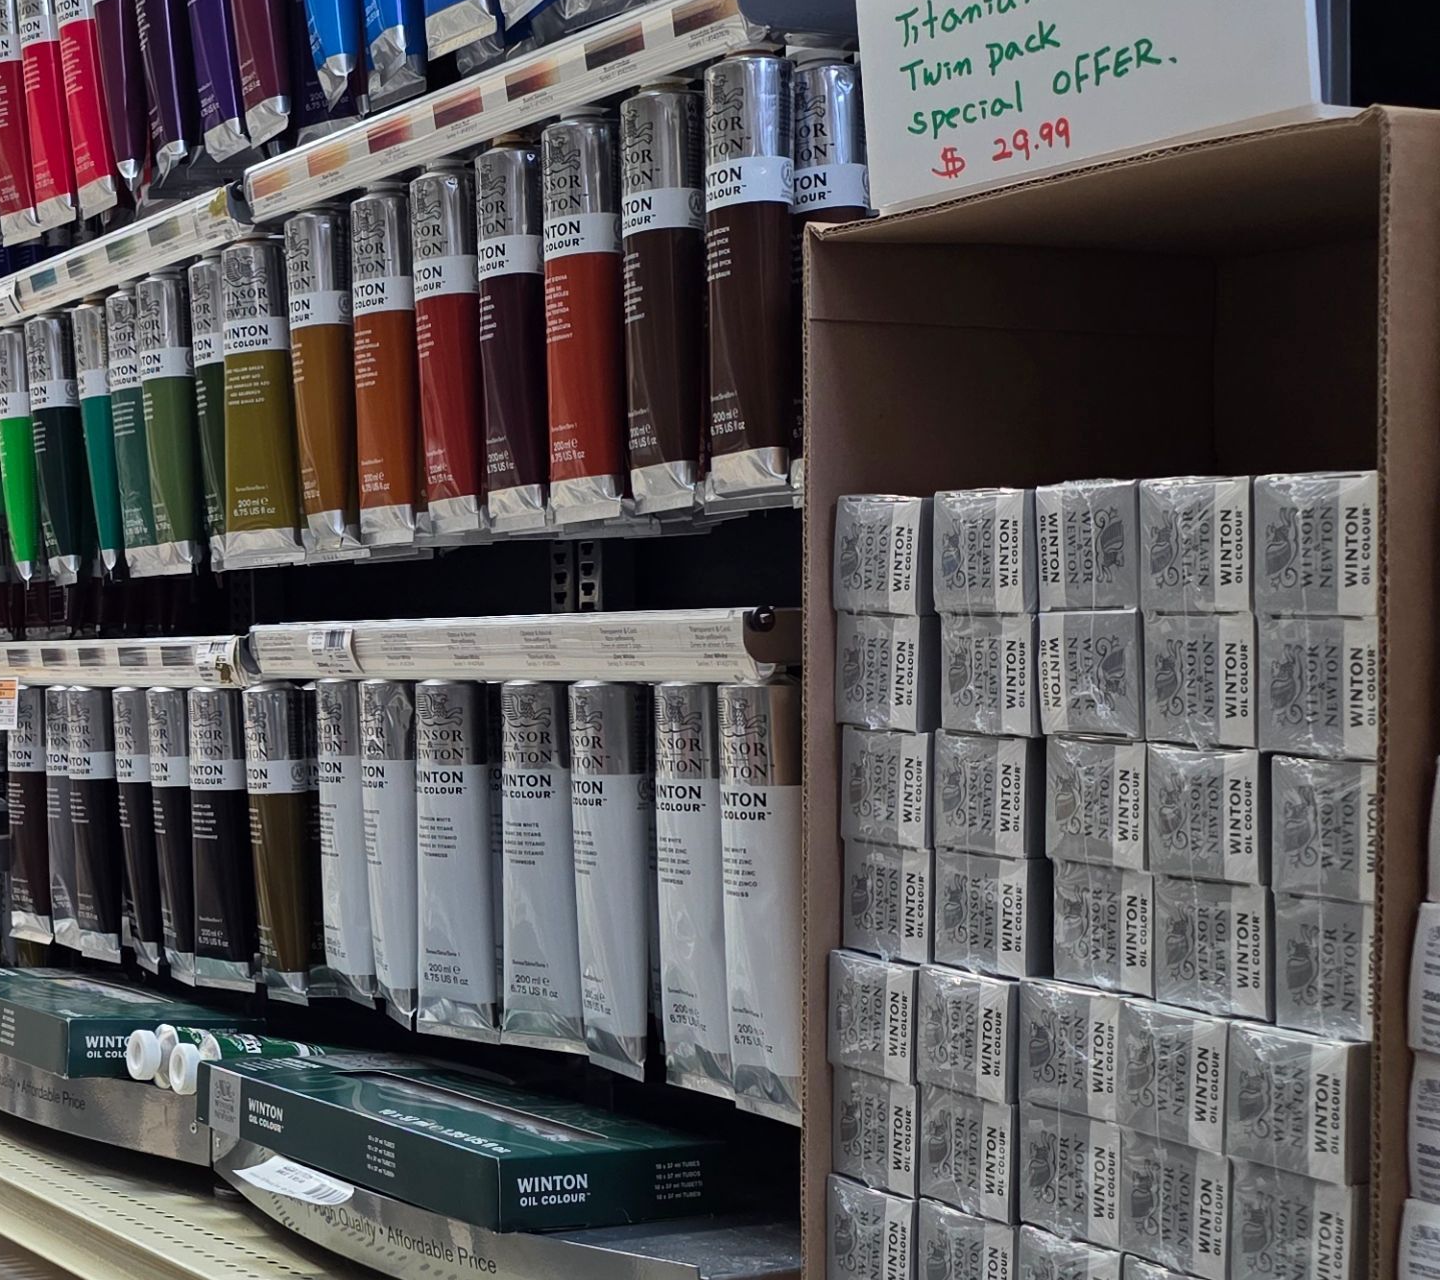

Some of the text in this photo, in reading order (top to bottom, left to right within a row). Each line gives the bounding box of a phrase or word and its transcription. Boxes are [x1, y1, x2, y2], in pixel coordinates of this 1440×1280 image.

[899, 57, 973, 91] Twin
[931, 117, 1072, 179] $ 29.99
[892, 526, 905, 593] WINTON
[1048, 513, 1060, 584] WINTON
[1345, 507, 1358, 588] WINTON
[1225, 642, 1237, 719] WINTON
[504, 730, 551, 744] INSOR
[722, 792, 767, 808] NTON
[85, 1035, 130, 1049] WINT
[86, 1048, 128, 1059] OIL COLO
[20, 1080, 60, 1104] Affordable
[61, 1091, 86, 1110] Price
[248, 1097, 284, 1121] WINTON
[517, 1173, 589, 1194] WINTON
[519, 1196, 539, 1207] OIL
[338, 1206, 377, 1244] Quality
[387, 1225, 455, 1263] Affordable
[457, 1246, 498, 1274] Price
